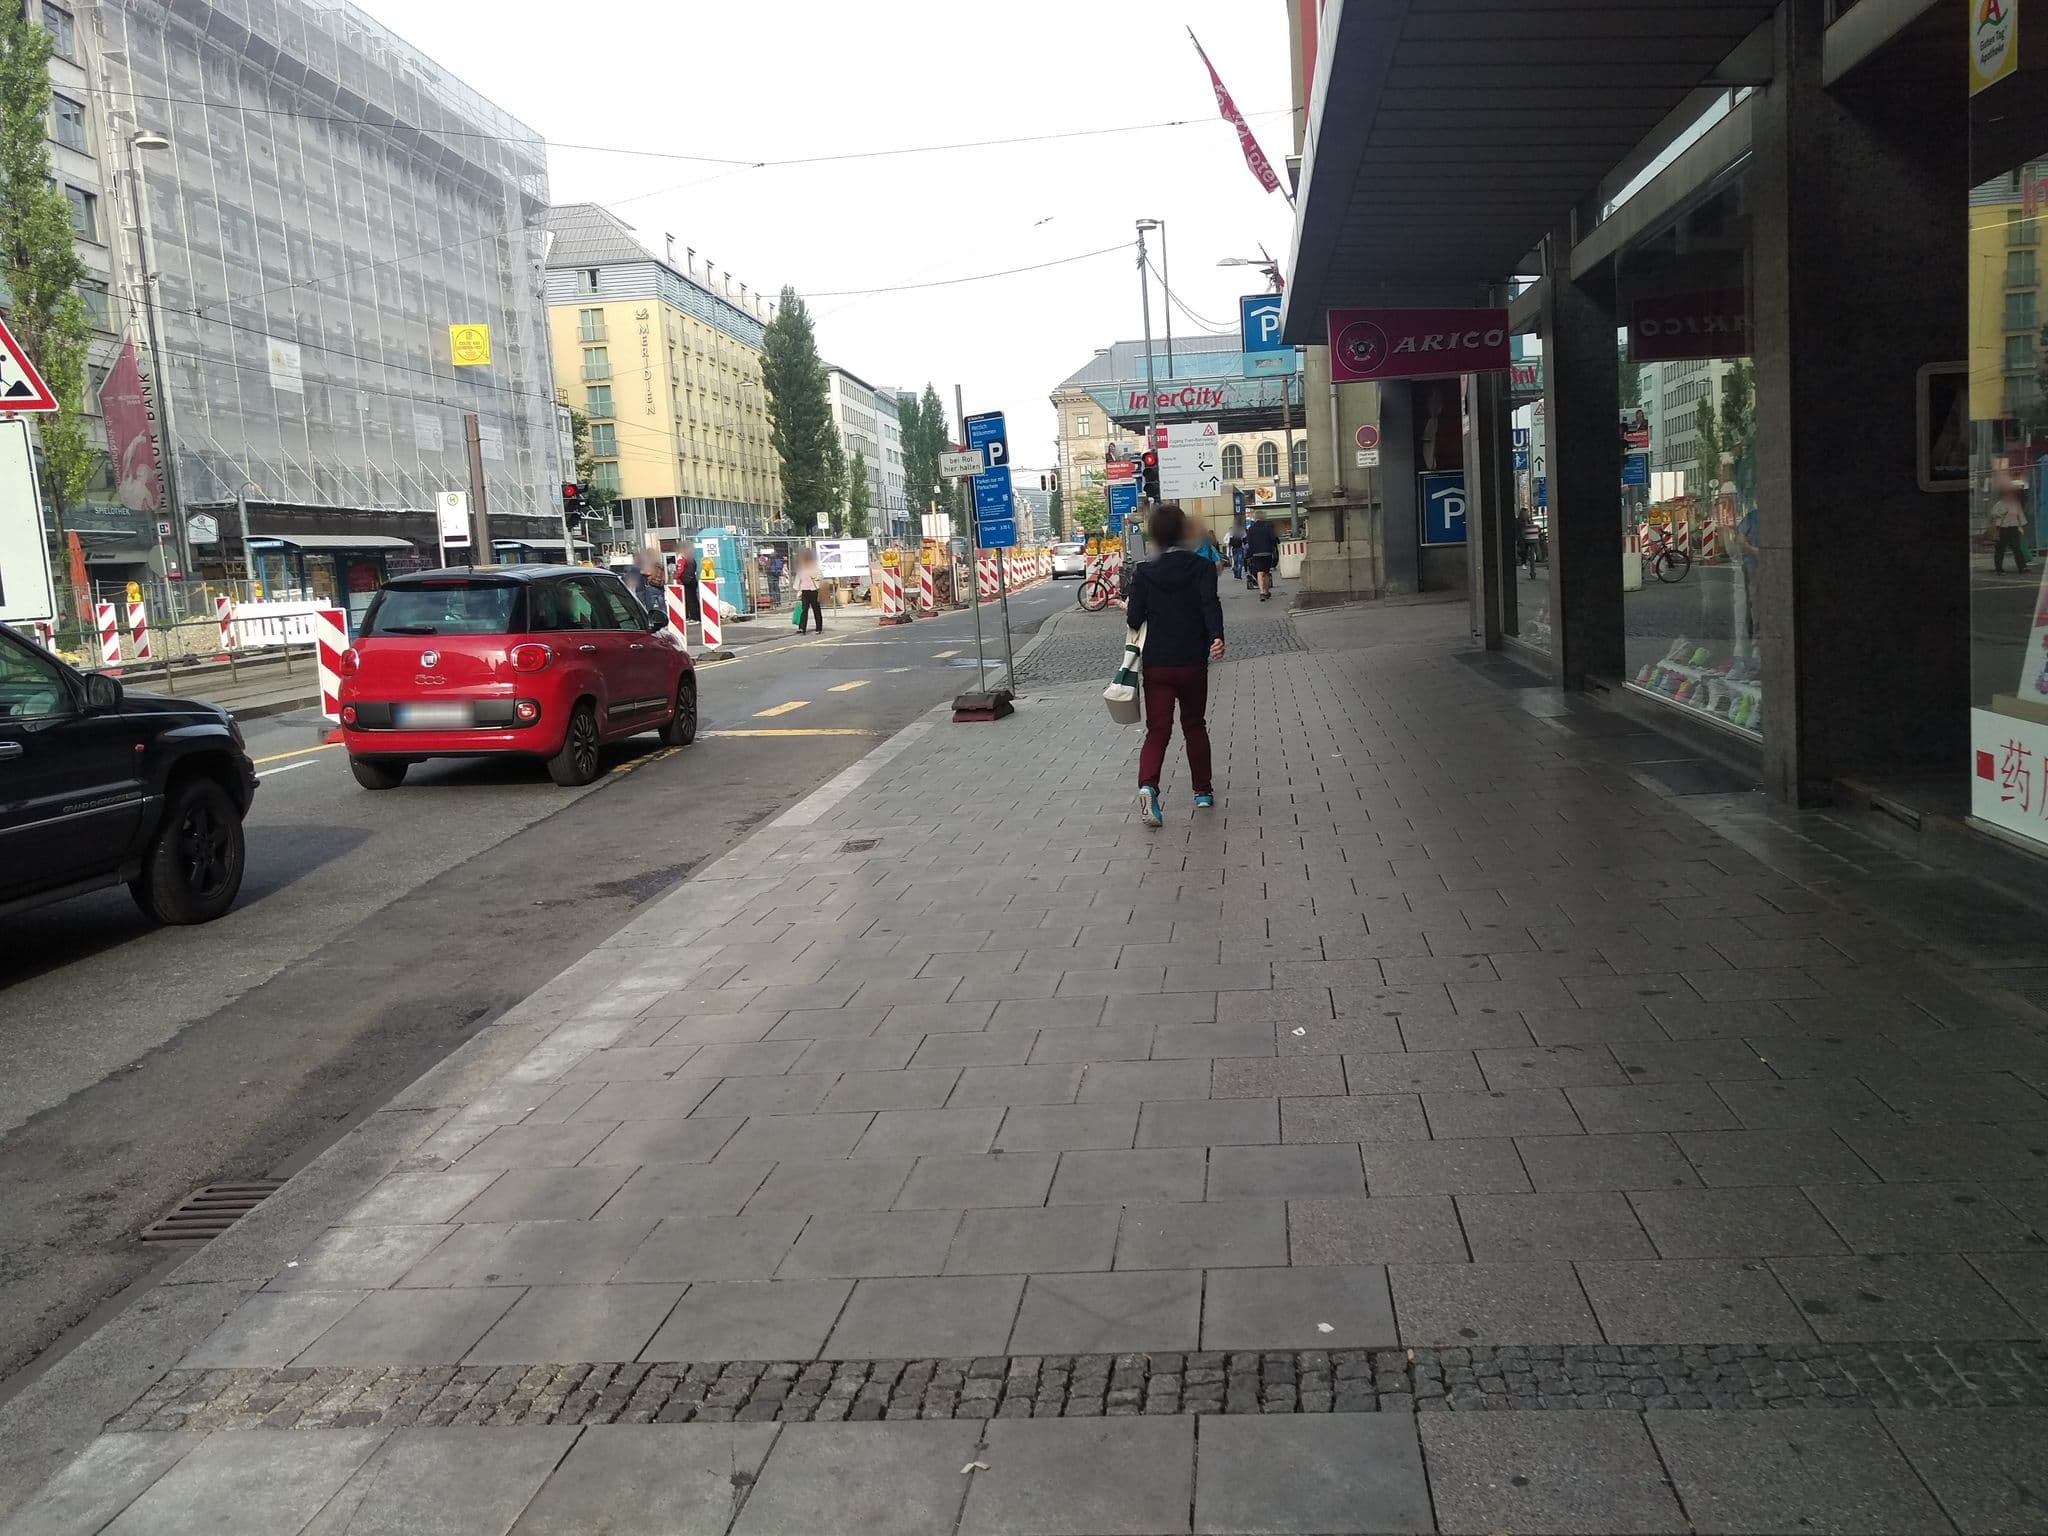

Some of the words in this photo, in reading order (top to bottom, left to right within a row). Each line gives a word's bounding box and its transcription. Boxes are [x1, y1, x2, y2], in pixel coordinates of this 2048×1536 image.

[1392, 329, 1504, 354] ARICO
[1128, 387, 1224, 409] InerCity
[988, 442, 1004, 466] P
[944, 465, 958, 473] hier
[959, 463, 981, 471] halten
[94, 506, 131, 516] SPIELOTHEK
[1444, 497, 1466, 529] P
